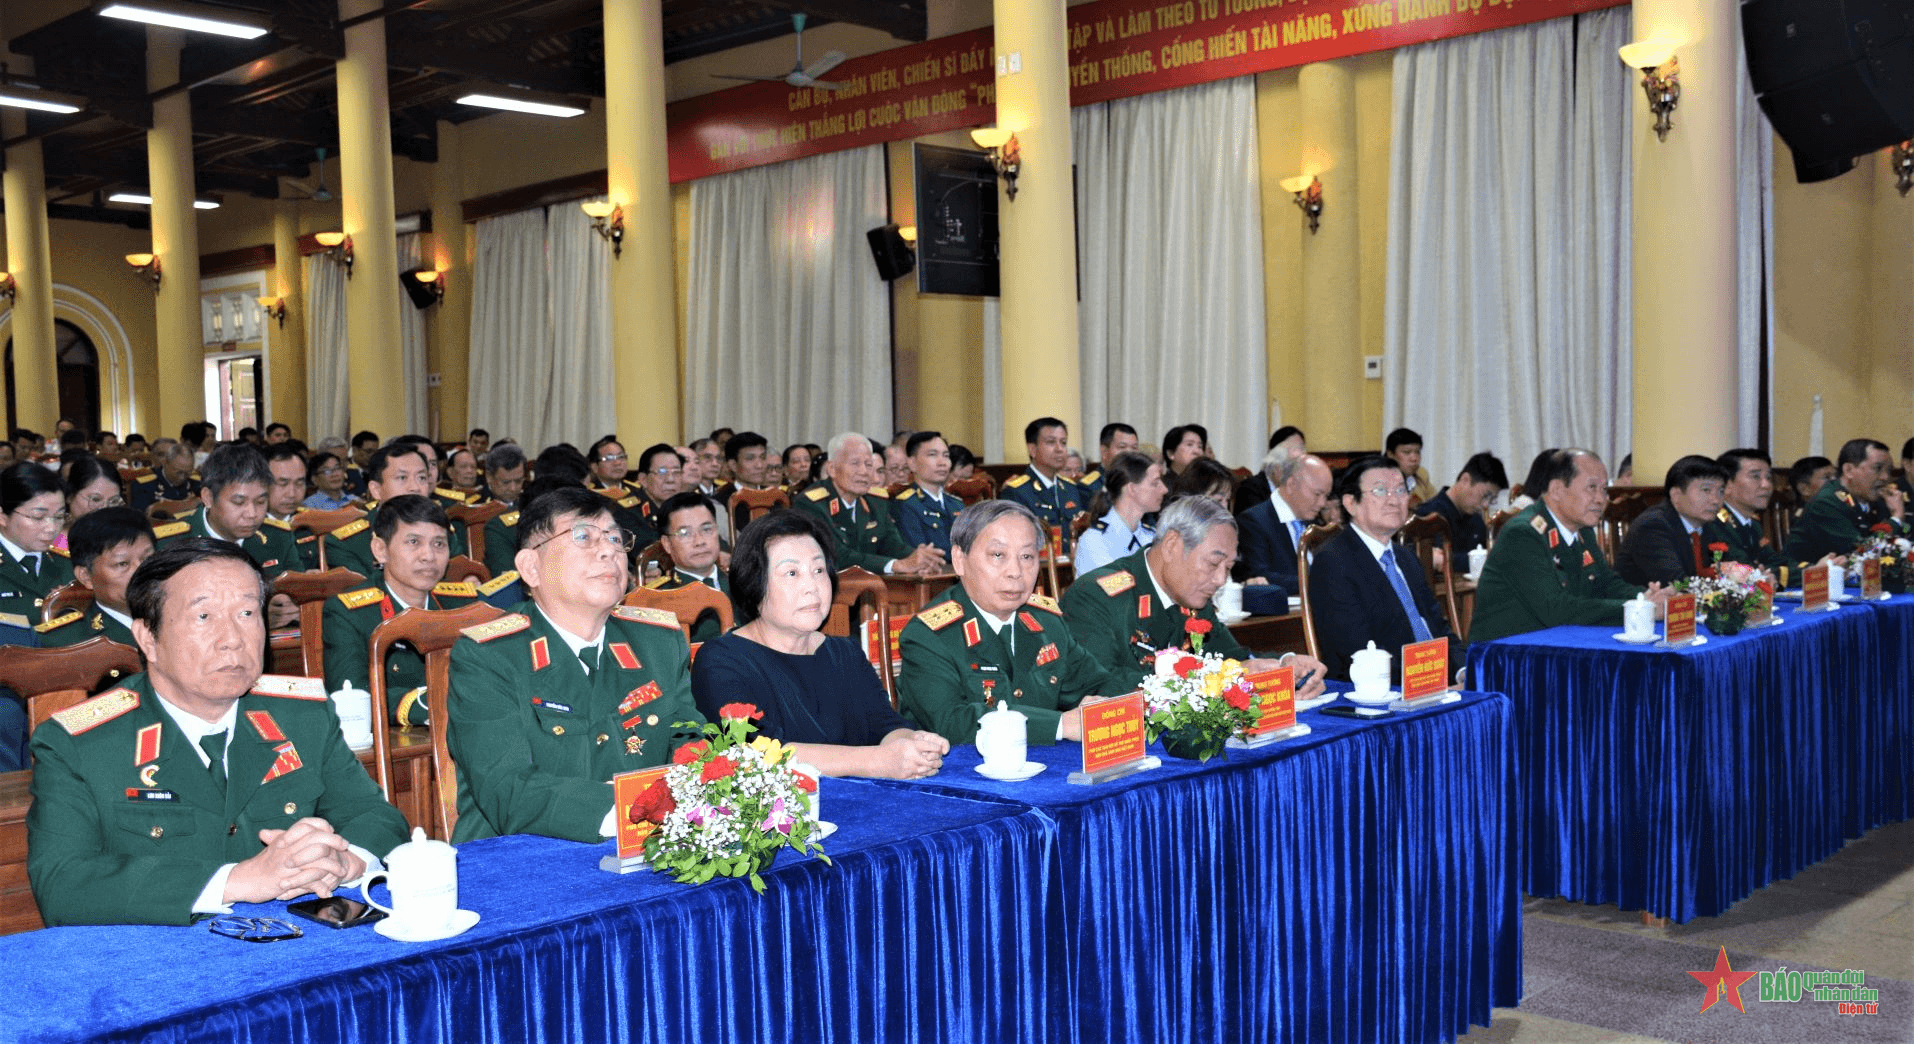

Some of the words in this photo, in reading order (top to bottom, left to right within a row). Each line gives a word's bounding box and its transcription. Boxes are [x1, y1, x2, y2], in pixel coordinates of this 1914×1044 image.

[903, 54, 940, 86] CHIẾN
[1096, 15, 1116, 44] VÀ
[1119, 9, 1152, 39] LÀM
[1155, 0, 1195, 30] THEO
[1161, 34, 1206, 70] CỐNG
[1208, 25, 1248, 60] HIẾN
[1251, 20, 1279, 52] TÀI
[1282, 13, 1338, 47] NĂNG,
